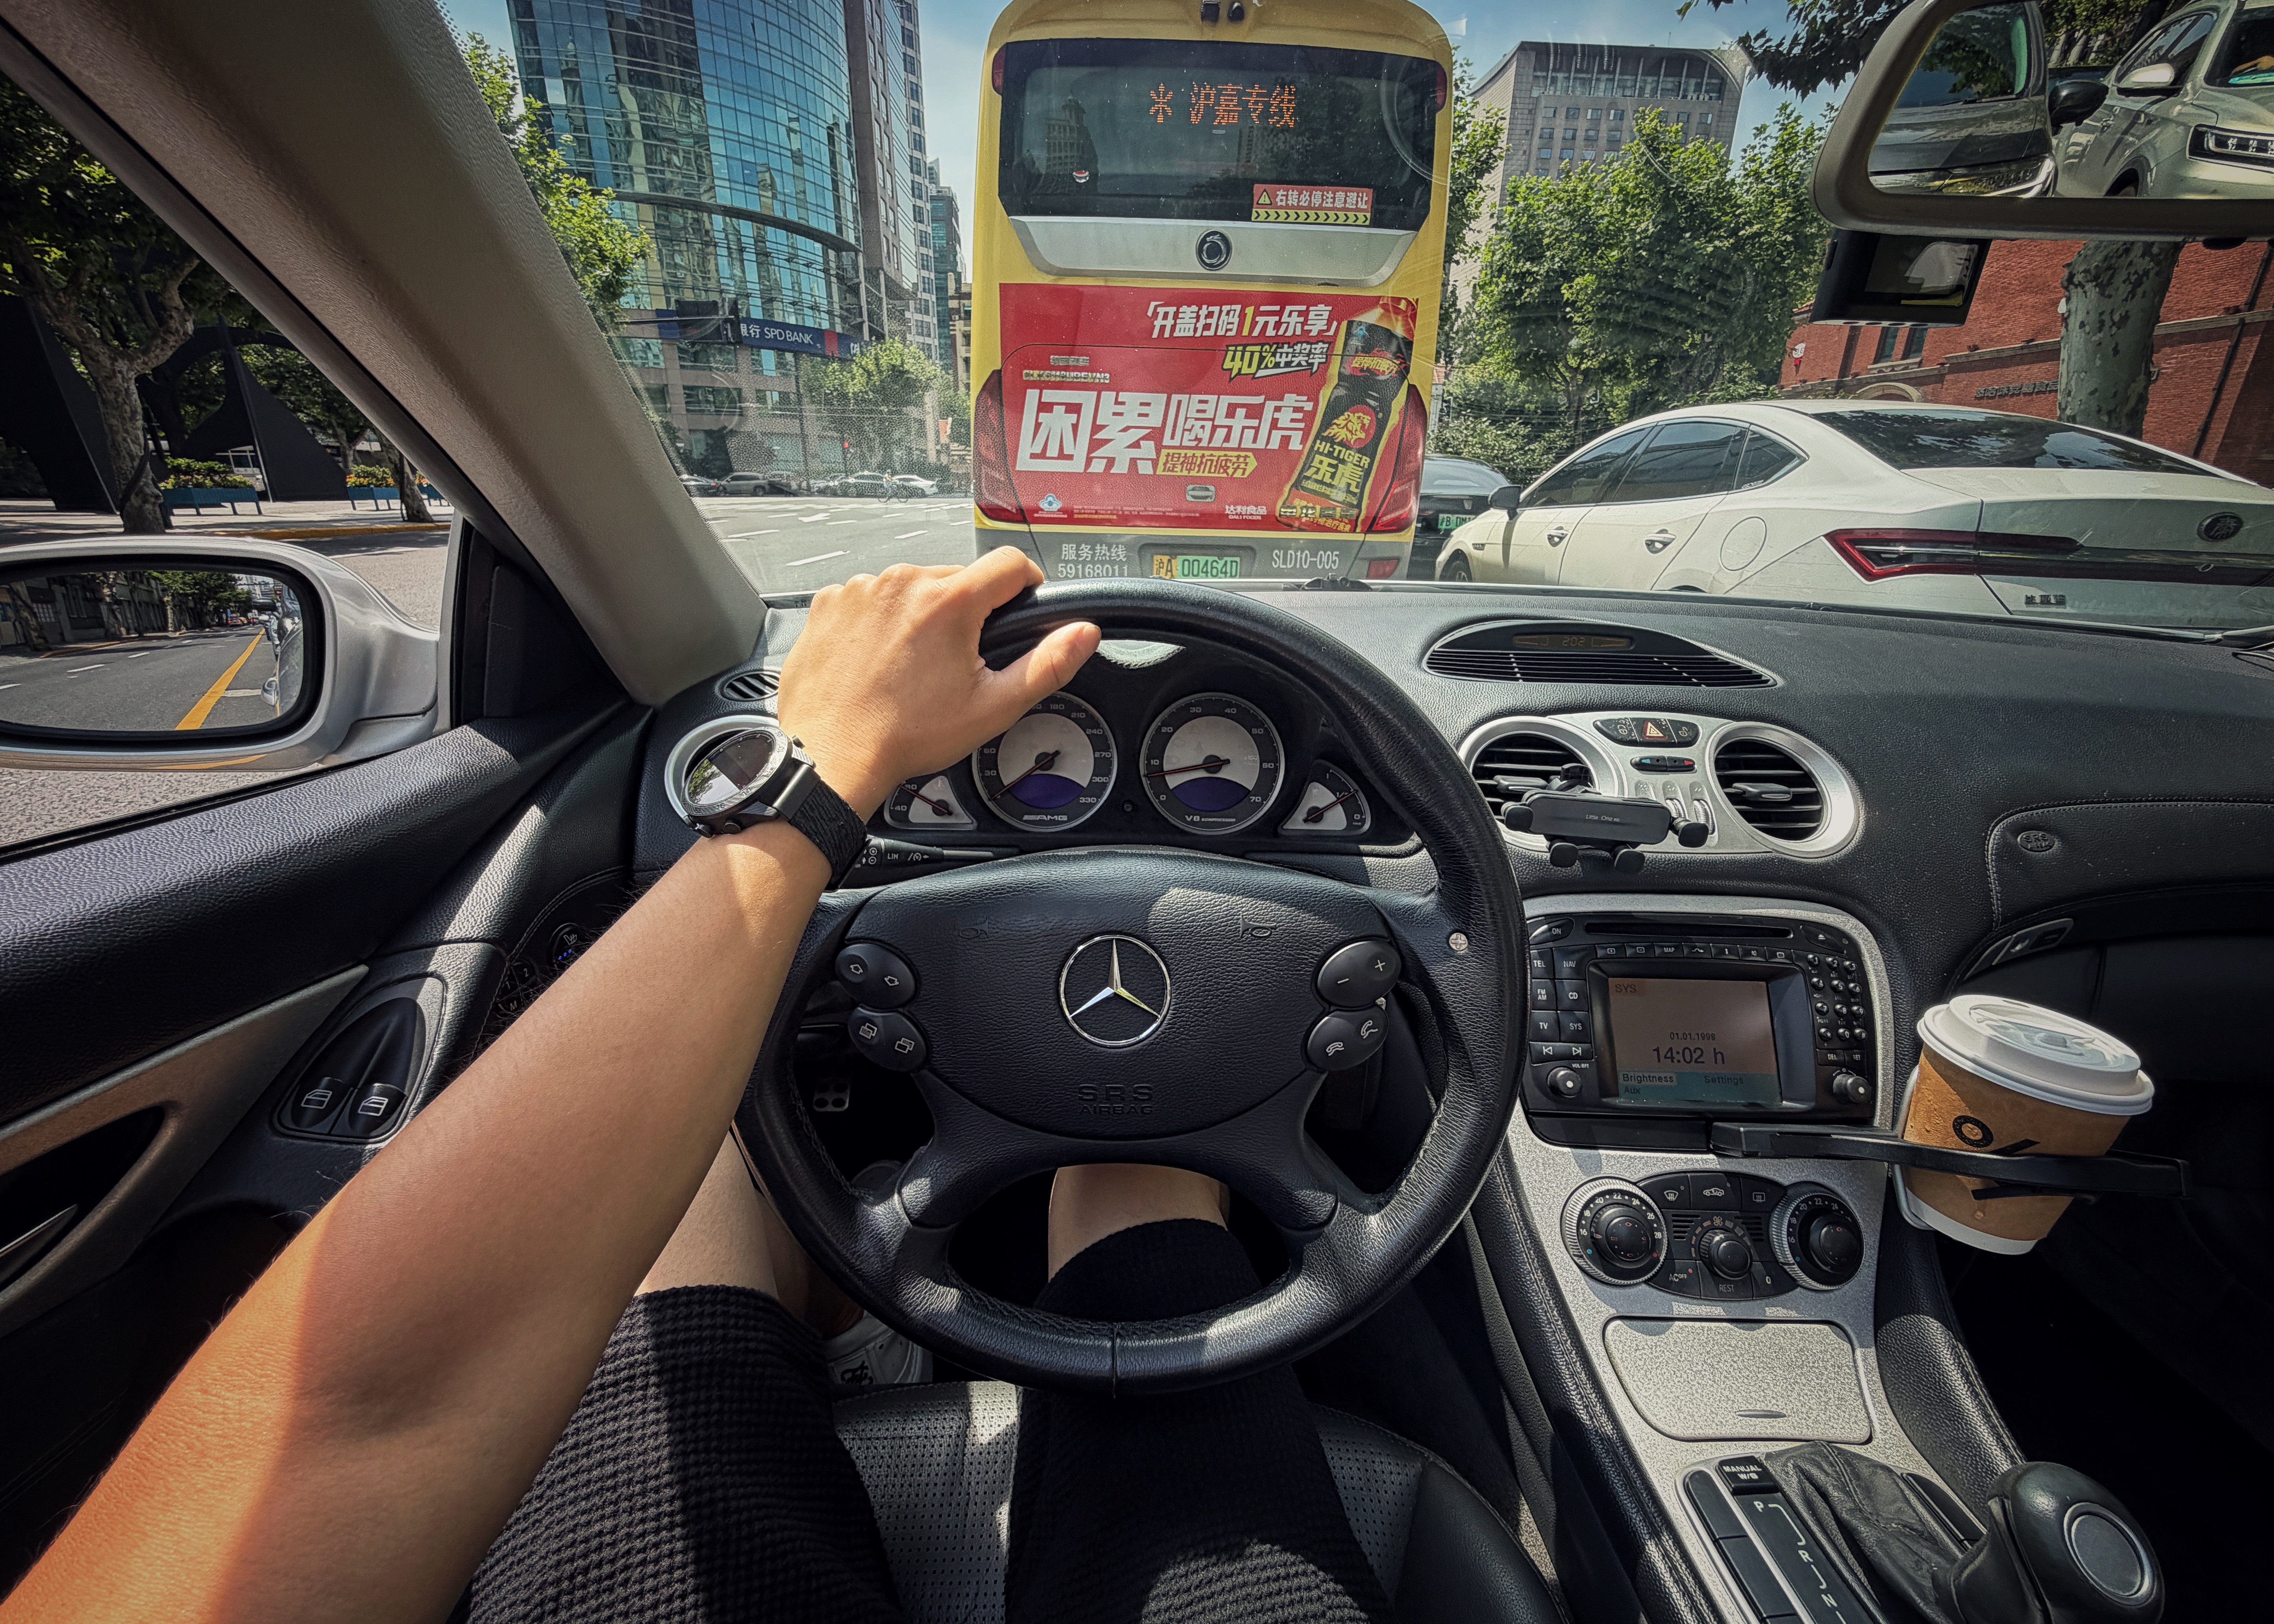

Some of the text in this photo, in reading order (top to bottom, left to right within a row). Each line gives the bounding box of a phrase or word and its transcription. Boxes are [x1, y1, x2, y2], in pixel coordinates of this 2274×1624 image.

[1189, 81, 1295, 127] 沪嘉专线
[1276, 189, 1368, 209] 右转必停注意避让
[764, 327, 785, 340] SPD
[786, 330, 813, 345] BANK
[1016, 389, 1313, 475] 困累喝乐虎
[1314, 440, 1370, 468] HI-TIGER
[1162, 452, 1250, 477] 提神抗疲劳
[1303, 455, 1364, 493] 乐虎
[1225, 505, 1267, 515] 达利食品
[1061, 544, 1127, 561] 服务热线
[1272, 550, 1339, 569] SLD10-005
[1058, 564, 1127, 578] 59168011
[1615, 984, 1637, 993] SYS
[1653, 1047, 1725, 1064] 14:02 h
[1623, 1074, 1744, 1085] Brightness Settings
[1625, 1086, 1641, 1095] Aux
[1079, 1105, 1153, 1115] AIRBAG
[1753, 1501, 1764, 1512] P
[1798, 1550, 1813, 1562] R
[1821, 1593, 1838, 1607] N
